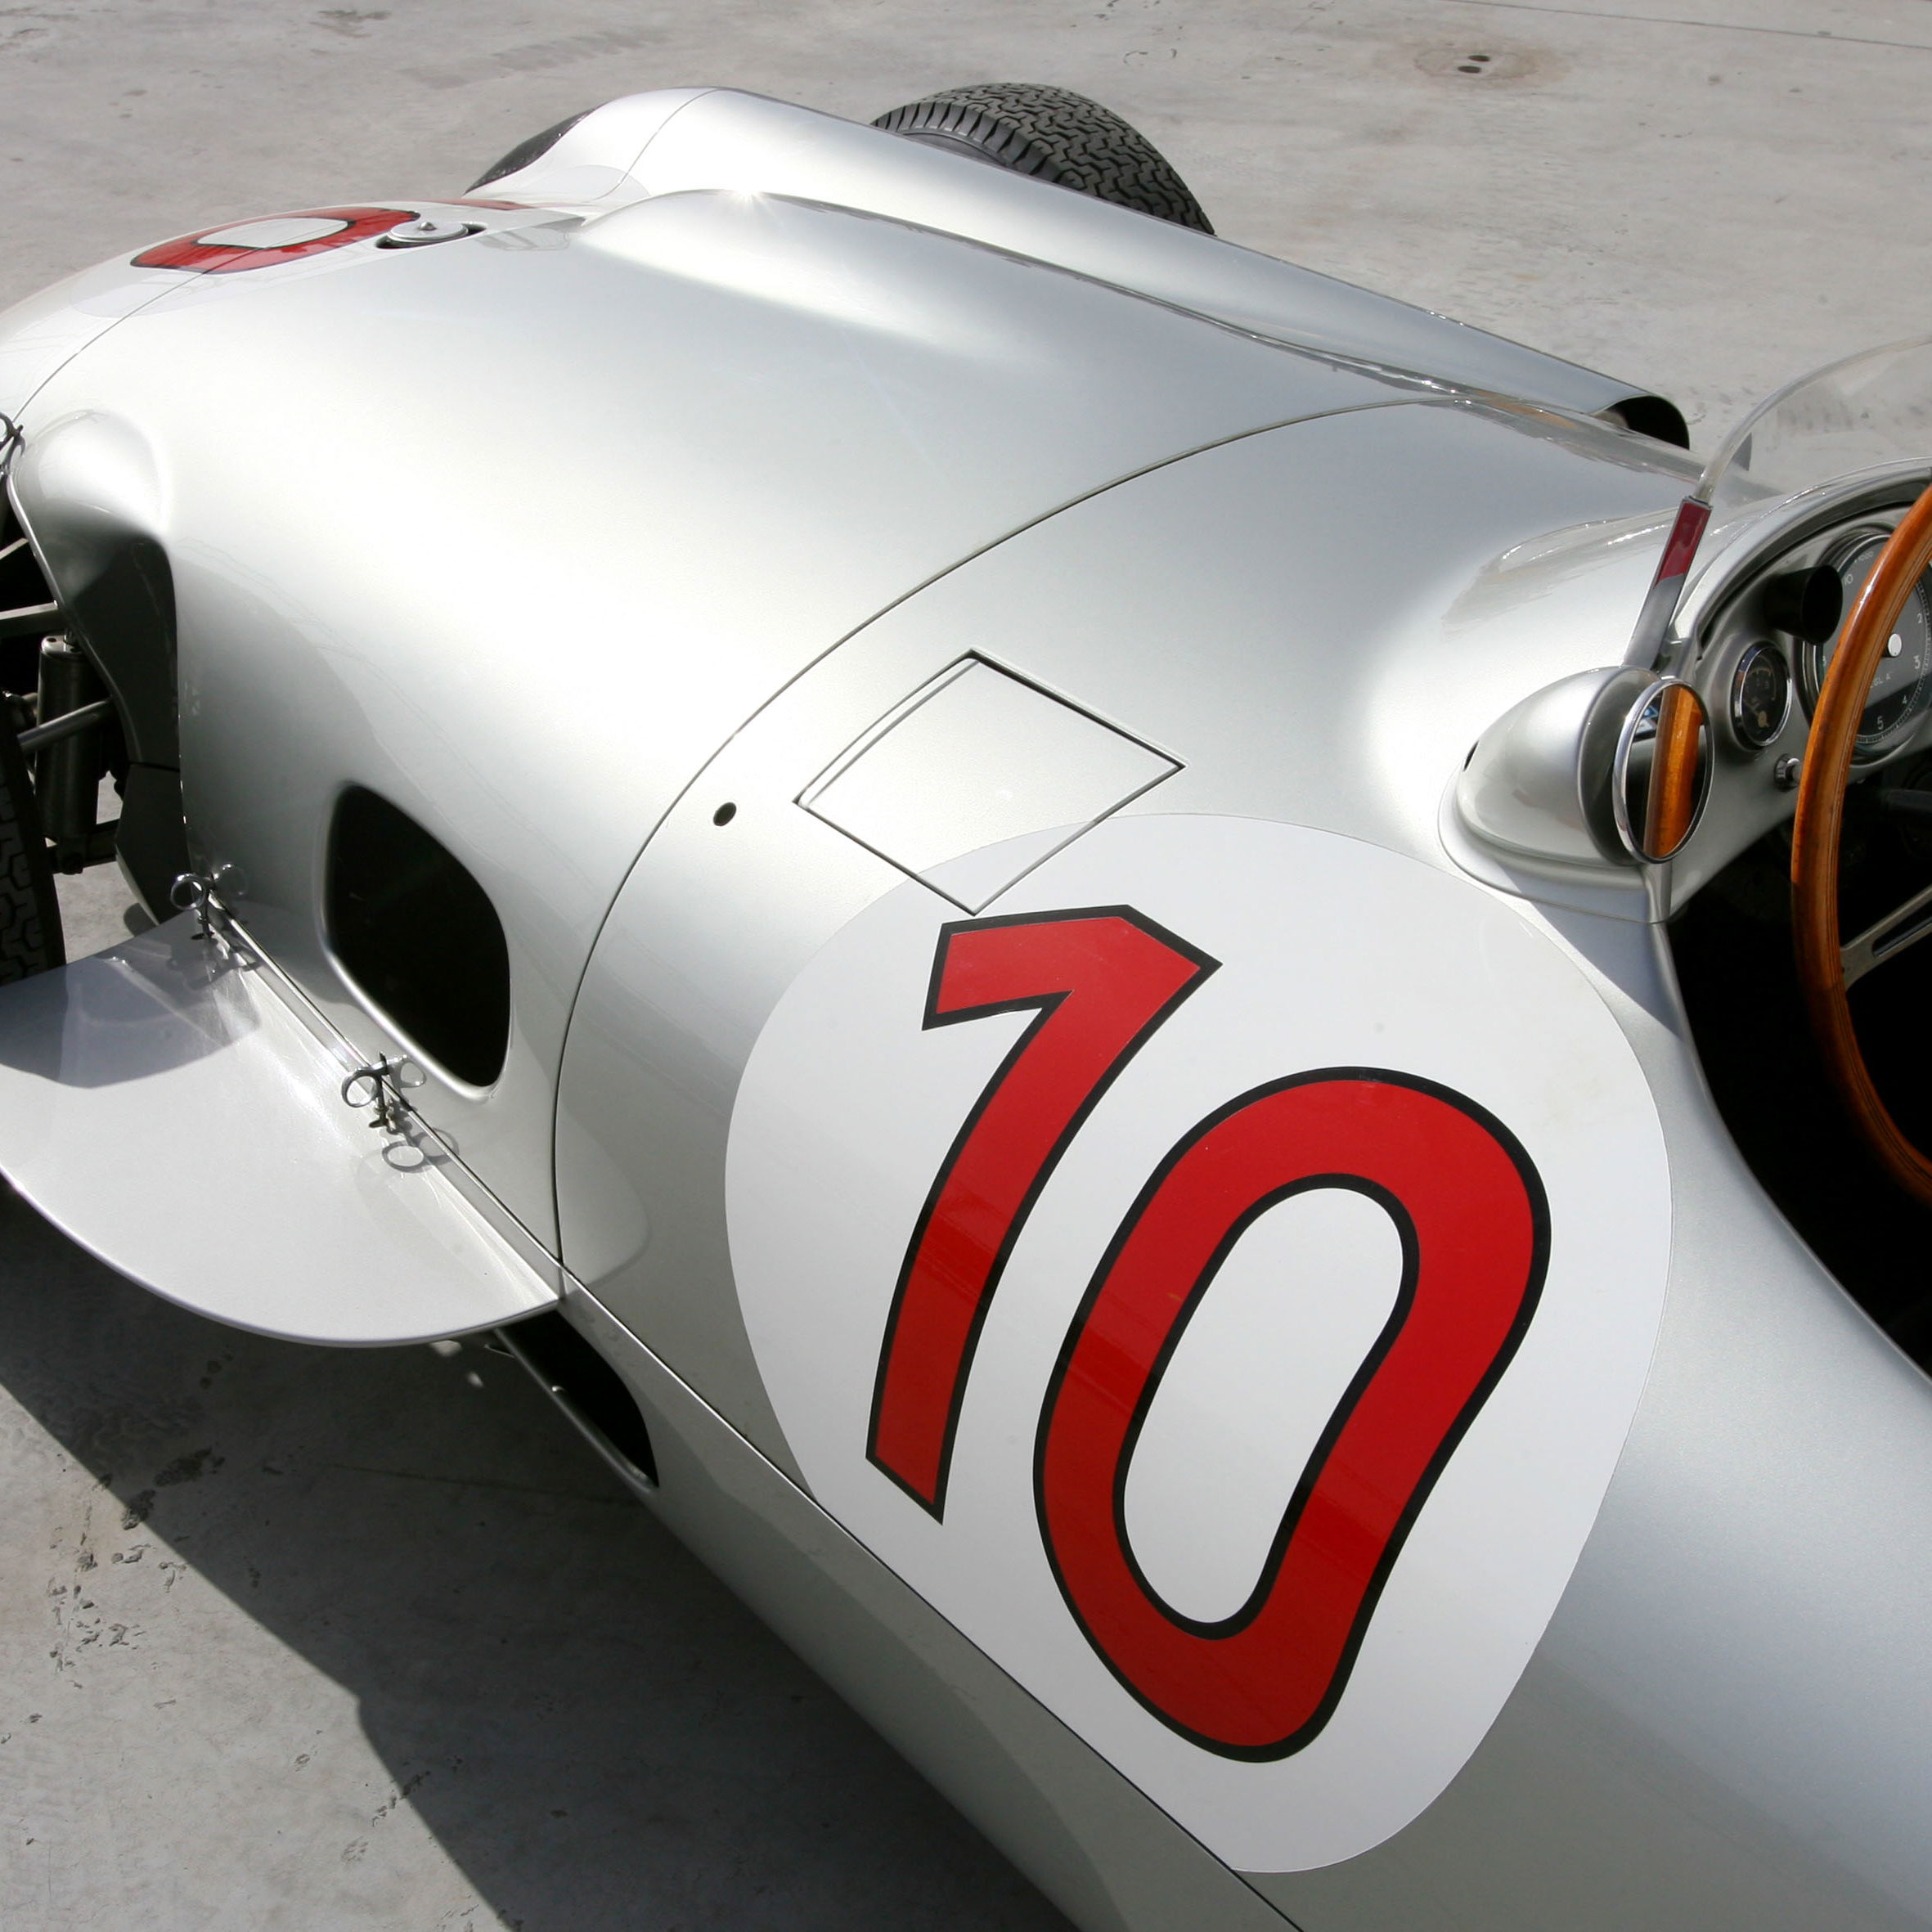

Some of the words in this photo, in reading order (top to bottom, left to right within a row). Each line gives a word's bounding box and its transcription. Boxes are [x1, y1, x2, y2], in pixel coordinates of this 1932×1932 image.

[1844, 573, 1853, 586] 10
[1916, 613, 1923, 623] 2
[1913, 655, 1921, 669] 3
[1902, 695, 1907, 704] 4
[1877, 716, 1884, 730] 5
[865, 905, 1552, 1762] 10
